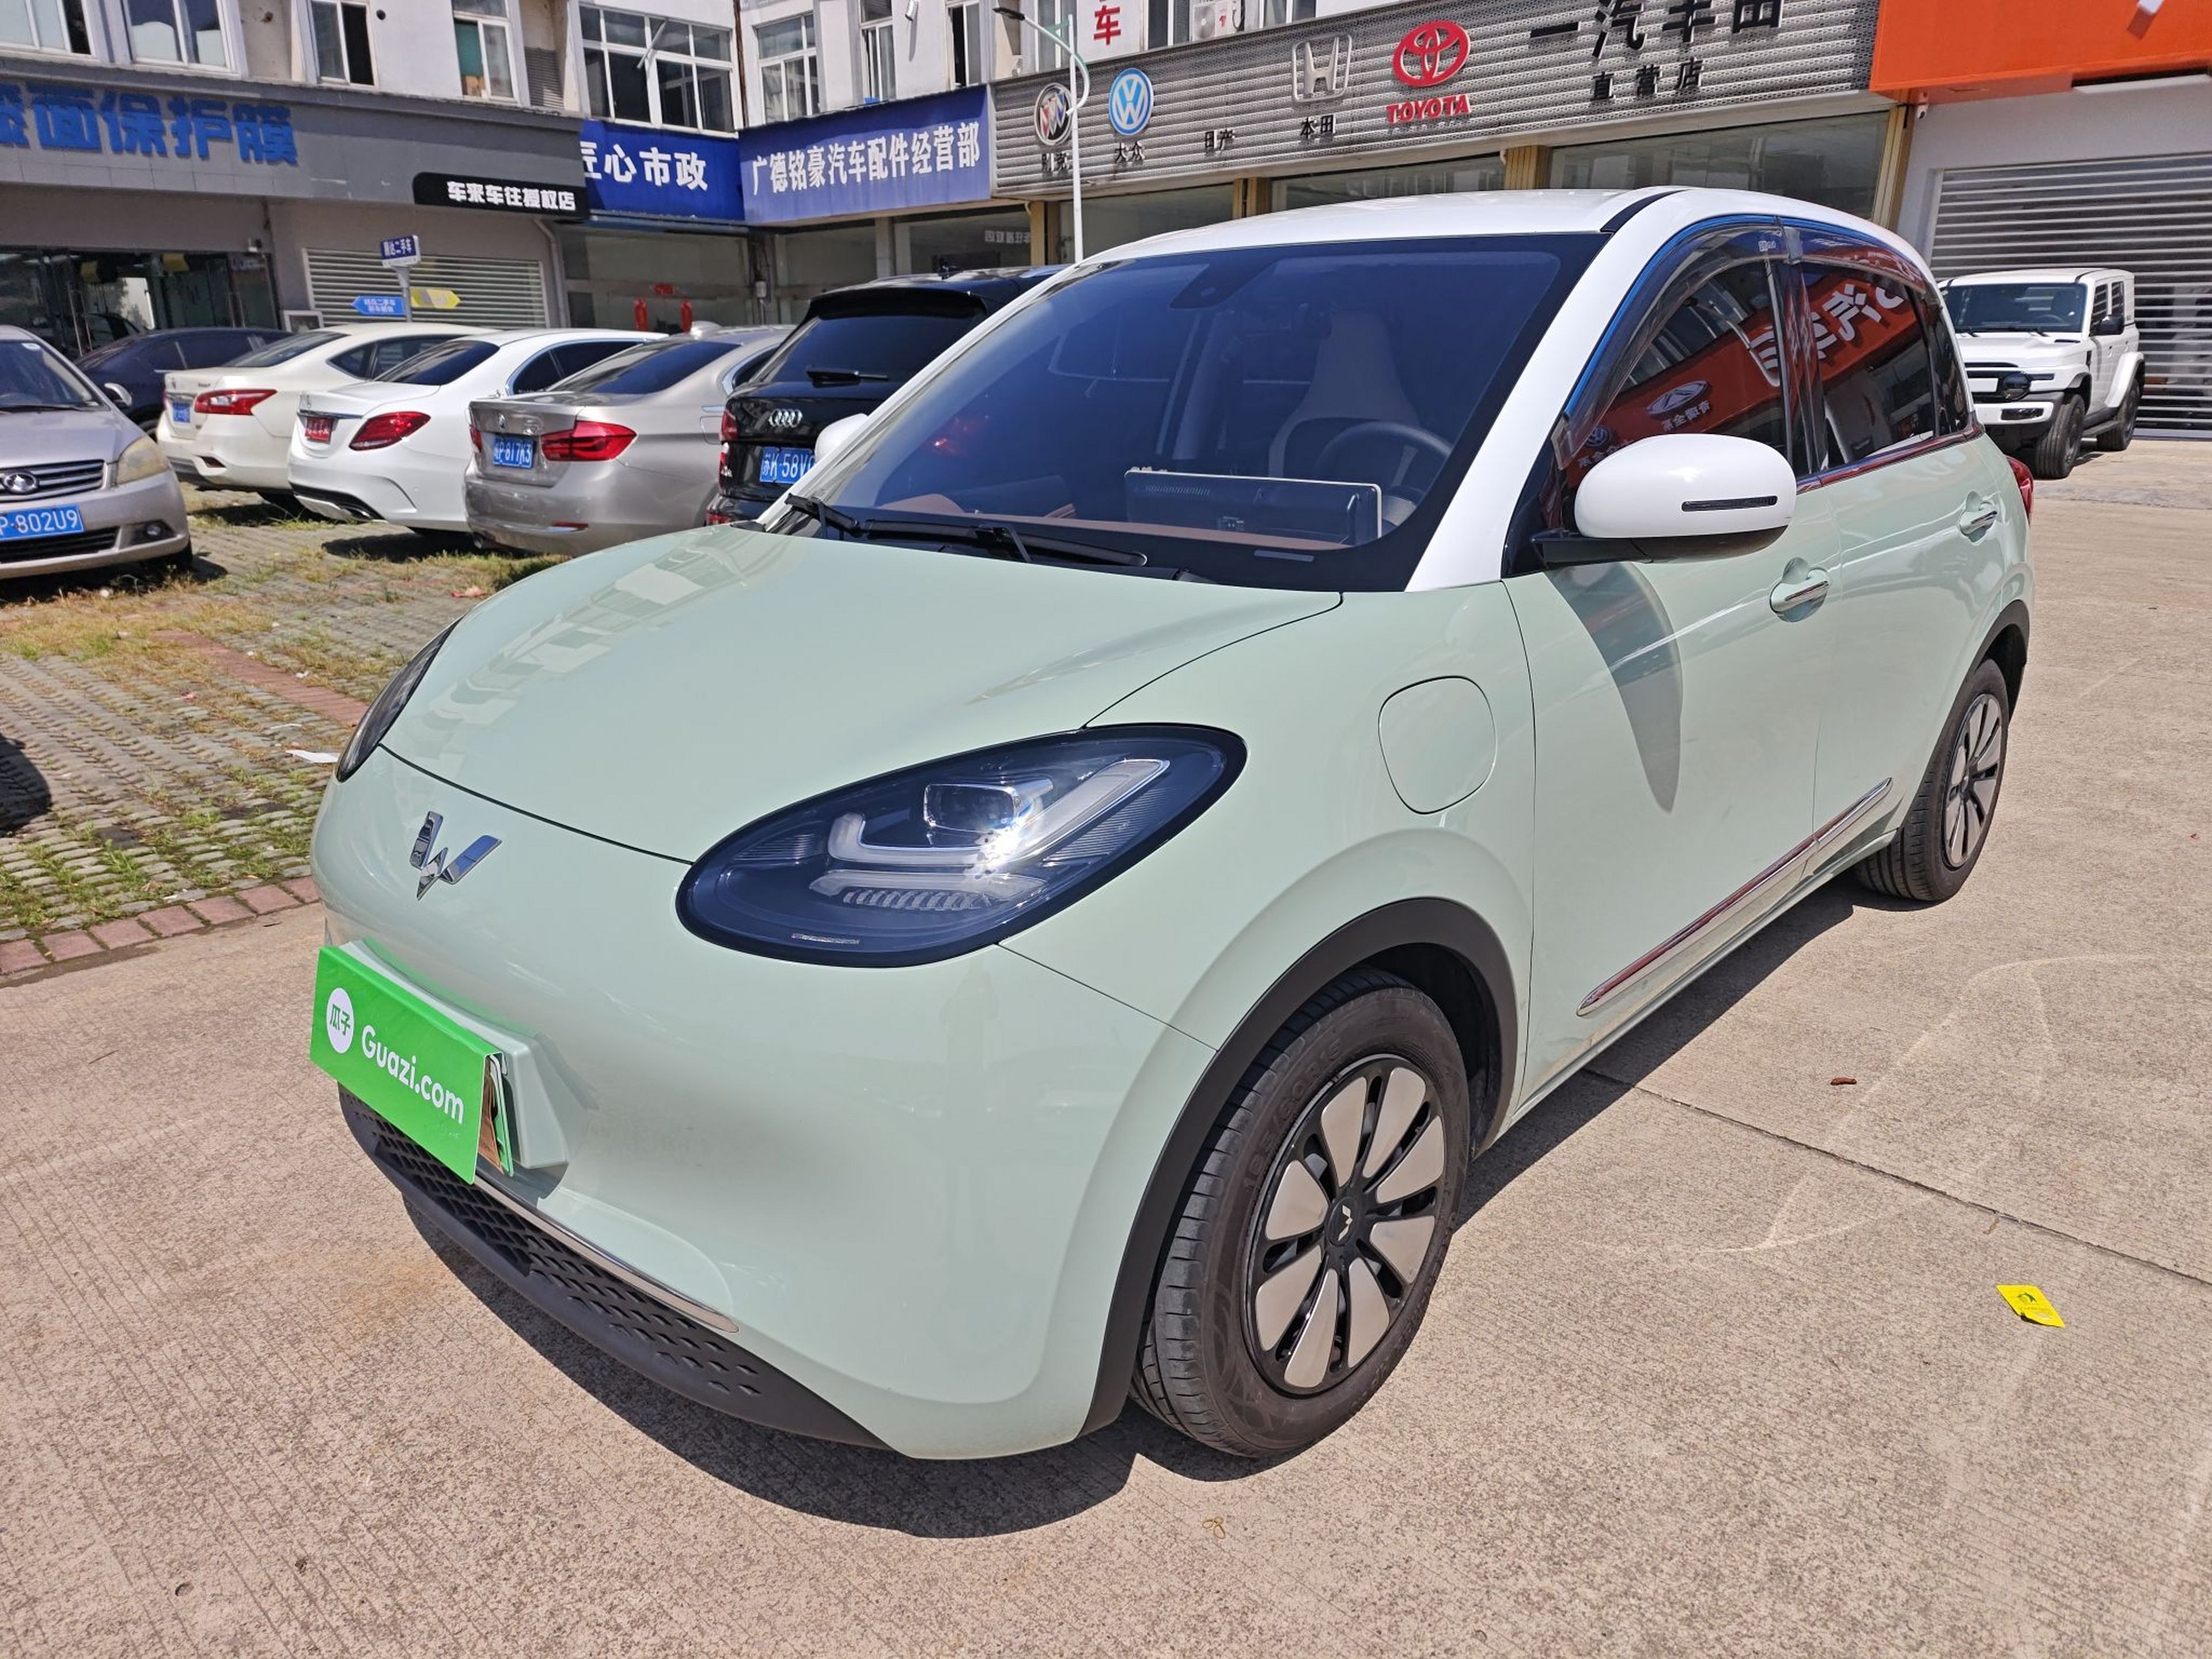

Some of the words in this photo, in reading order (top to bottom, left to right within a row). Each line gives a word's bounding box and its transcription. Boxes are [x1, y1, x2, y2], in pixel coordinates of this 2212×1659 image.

[1592, 57, 1705, 101] 直营店
[1386, 94, 1471, 124] TOYOTA
[1204, 128, 1236, 151] 日产
[1300, 114, 1336, 139] 本田
[752, 120, 980, 196] 广德铭豪汽车配件经营部
[1114, 141, 1146, 164] 大众
[446, 181, 576, 212] 车来车往授权店
[329, 1003, 351, 1036] 瓜子
[361, 1025, 464, 1124] Guazi.com
